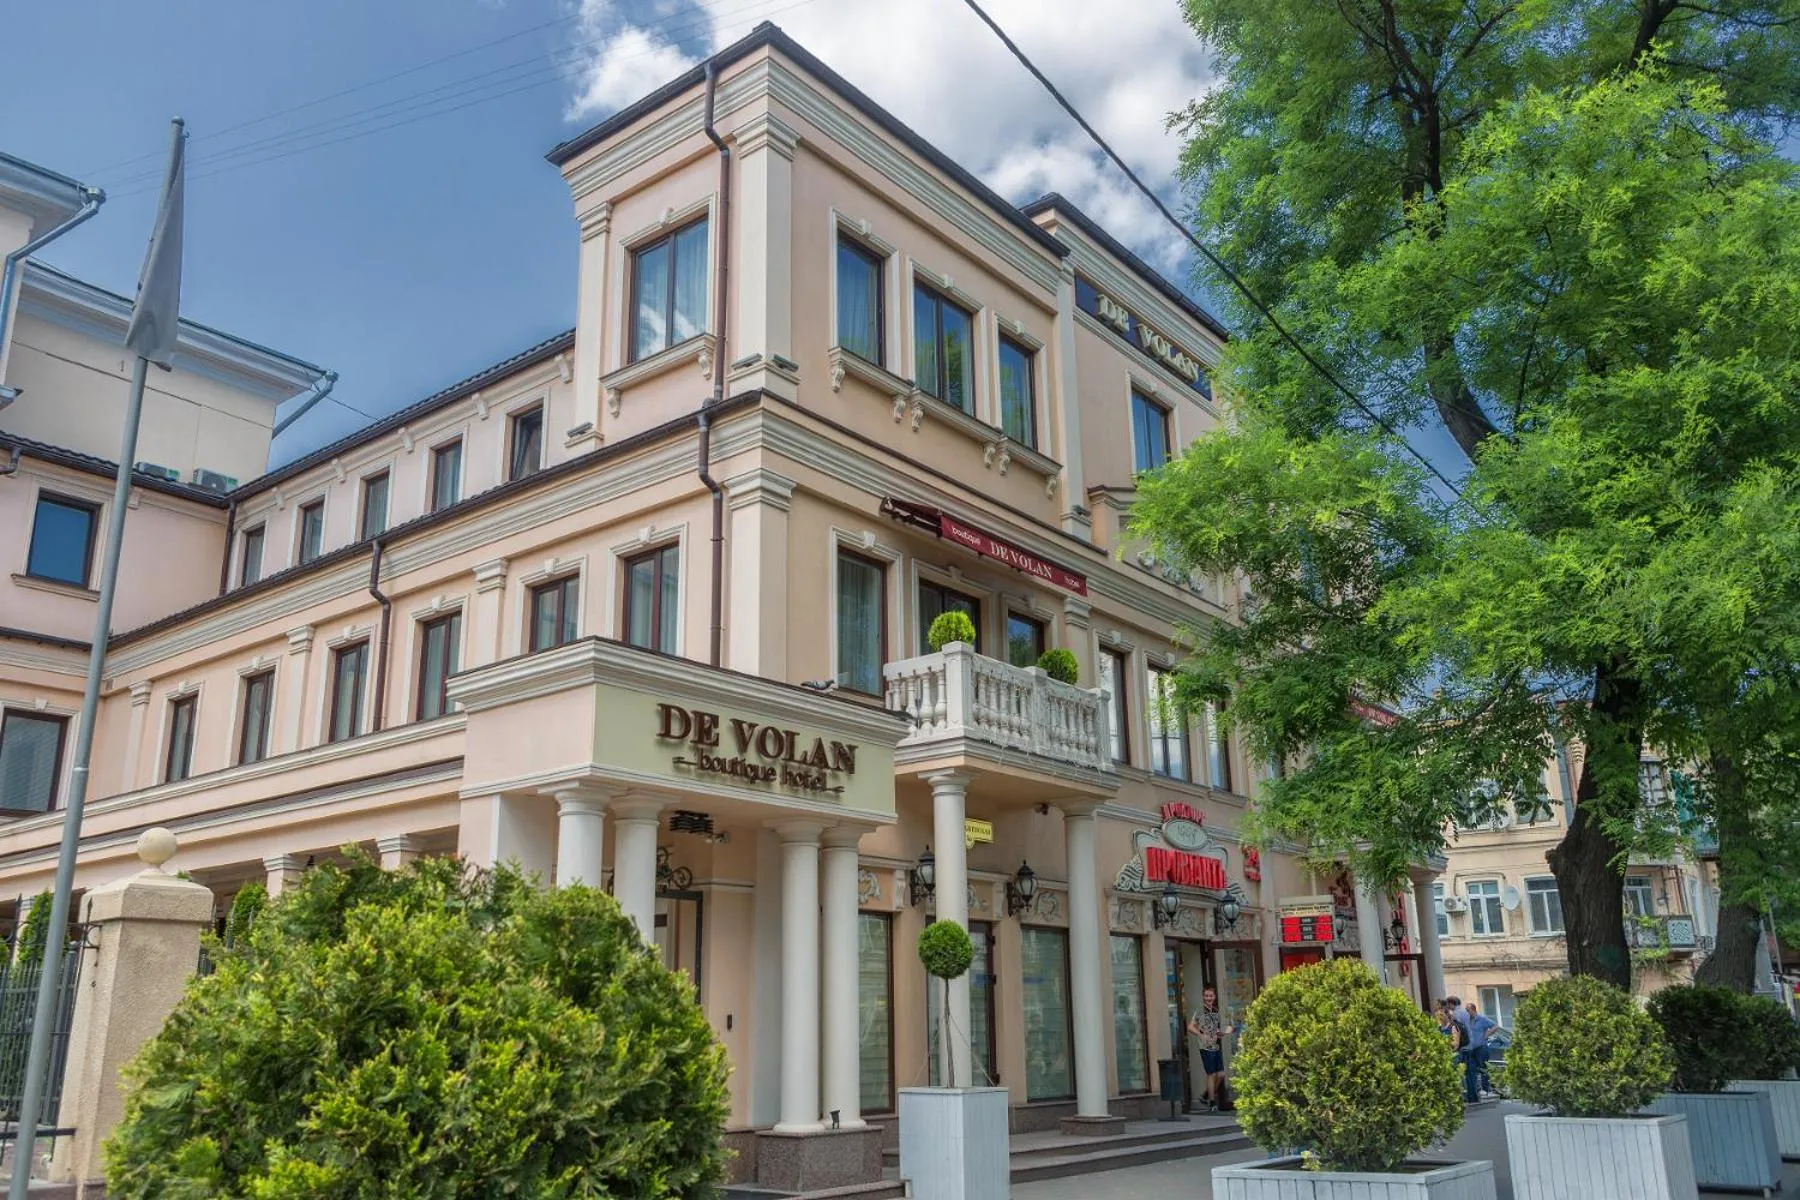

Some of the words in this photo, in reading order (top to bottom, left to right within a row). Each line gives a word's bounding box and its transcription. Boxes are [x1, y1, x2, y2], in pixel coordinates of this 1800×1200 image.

[1097, 293, 1130, 333] DE
[1137, 323, 1200, 383] VOLAN
[952, 525, 982, 546] boutique
[990, 542, 1009, 560] DE
[1010, 550, 1053, 579] VOLAN
[656, 702, 720, 747] DE
[730, 718, 859, 775] VOLAN
[697, 748, 777, 784] boutique
[780, 764, 828, 791] hotel
